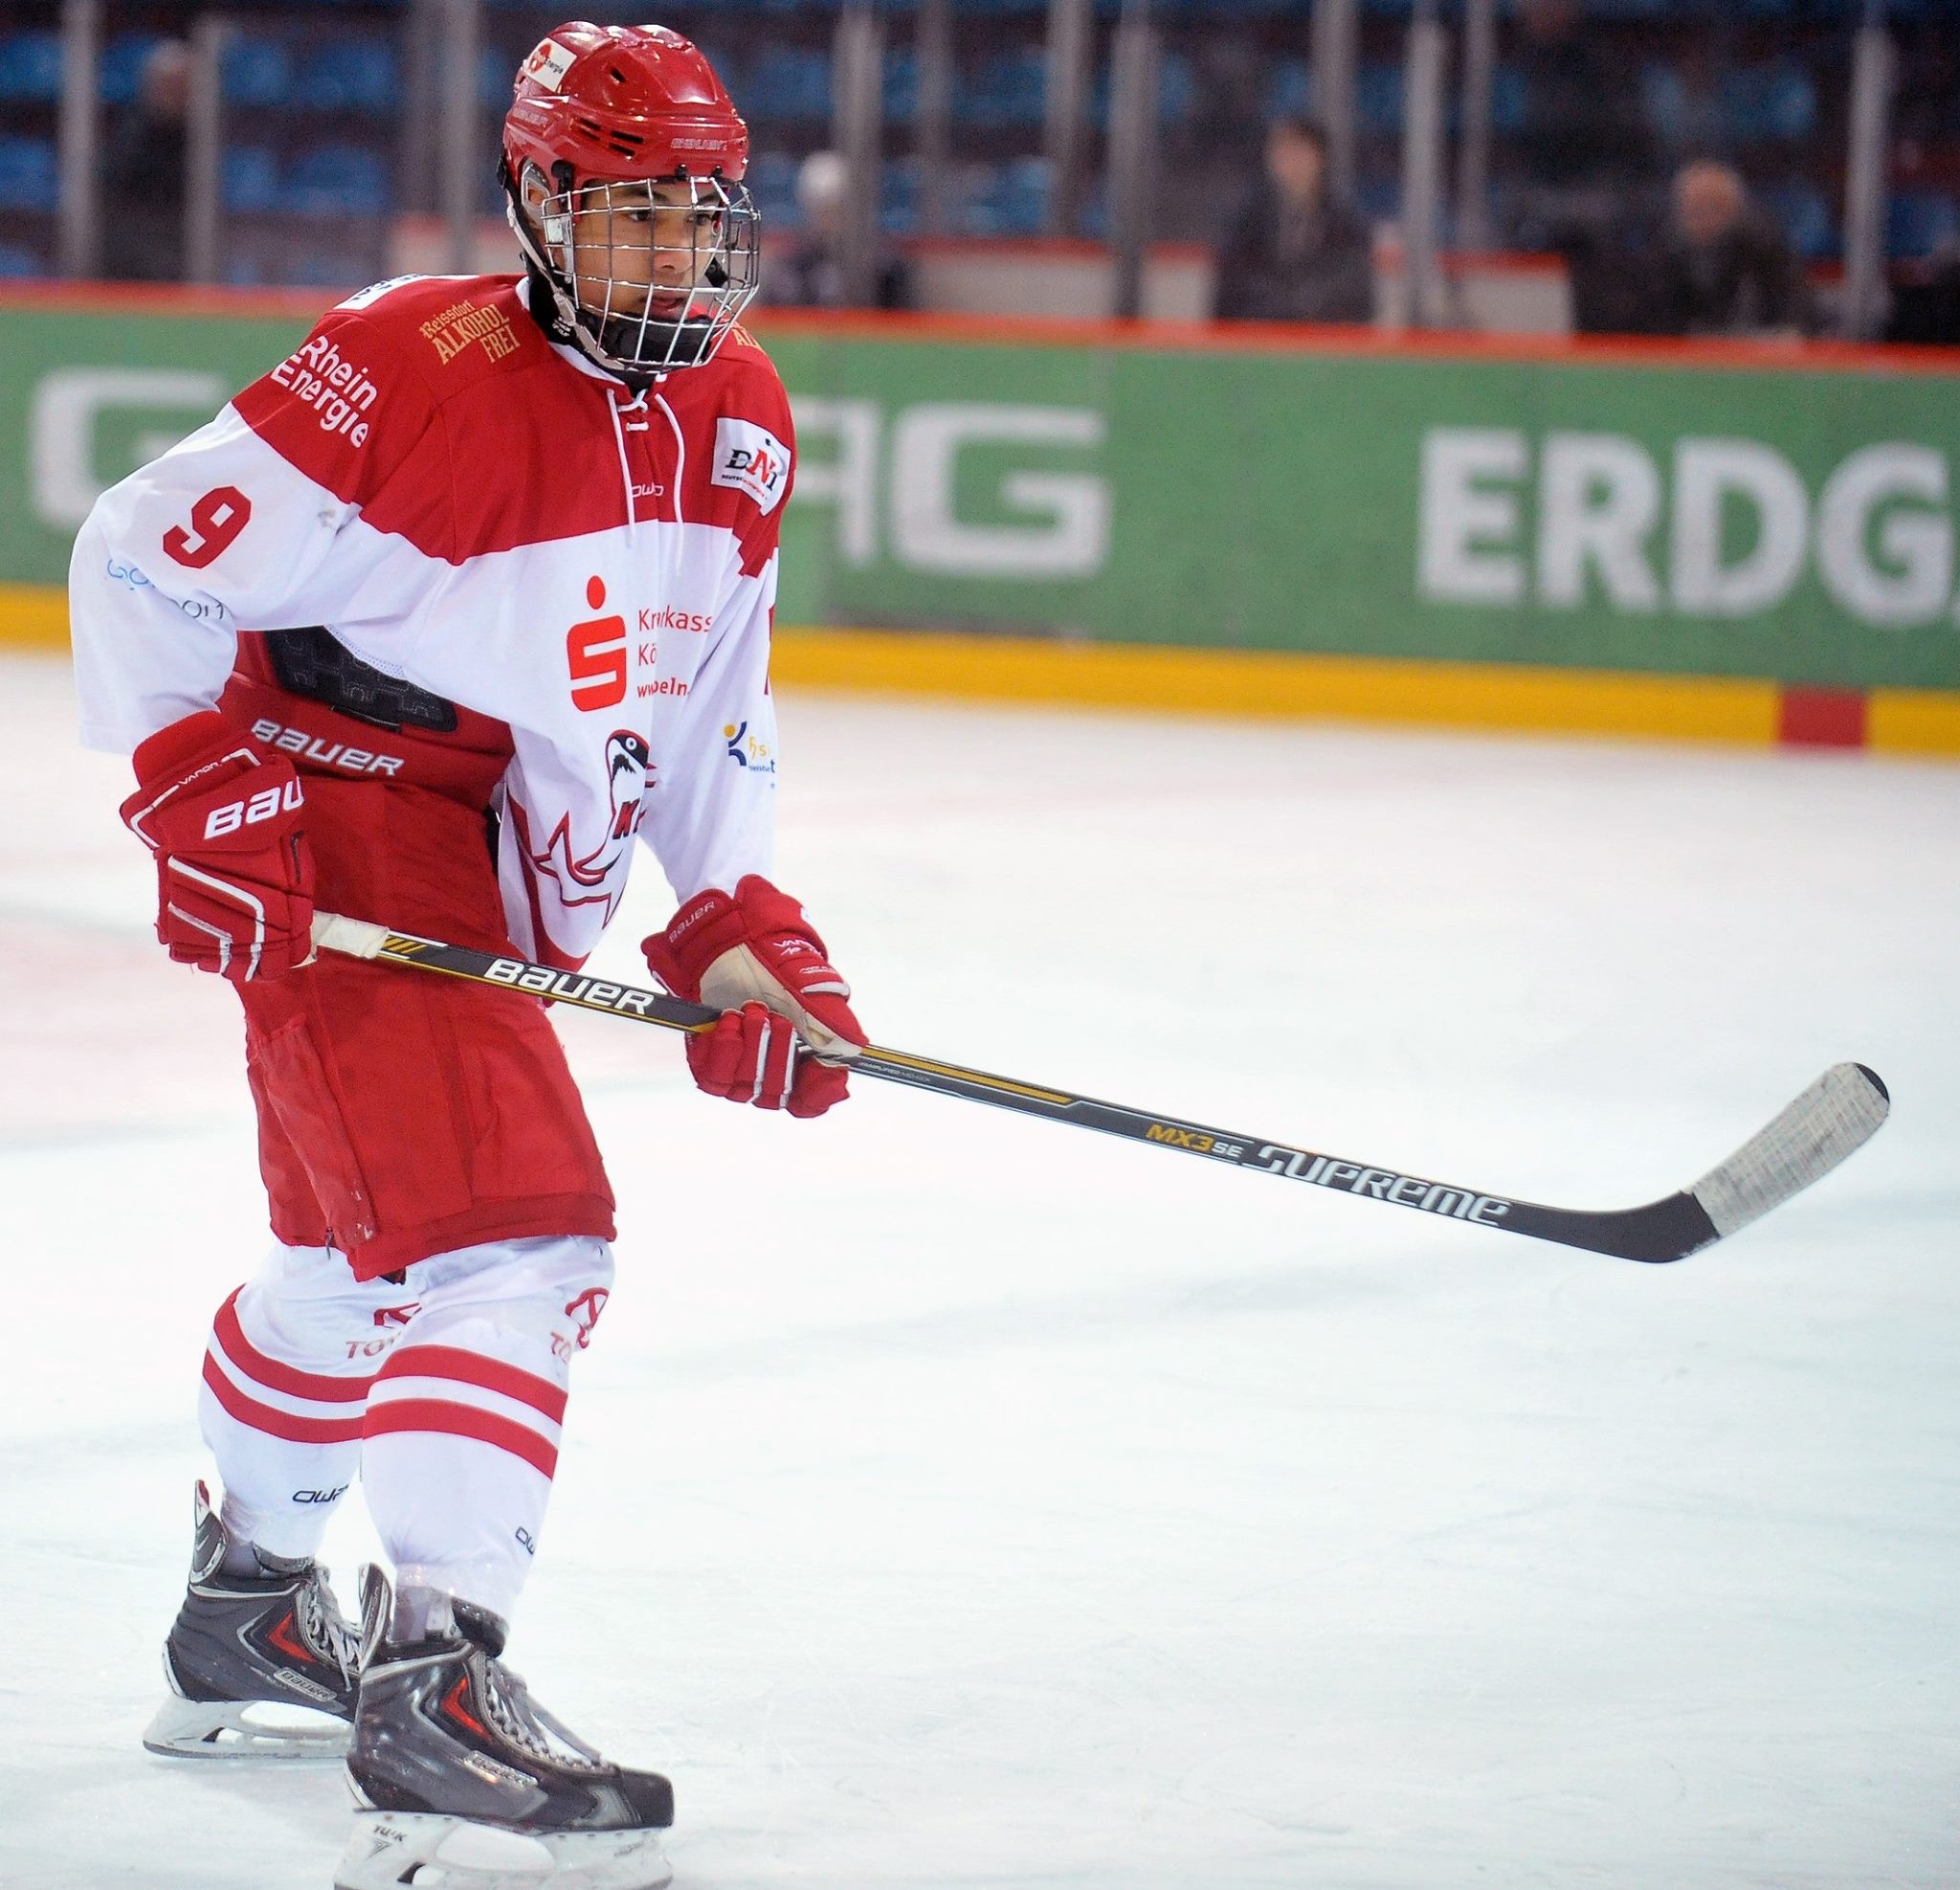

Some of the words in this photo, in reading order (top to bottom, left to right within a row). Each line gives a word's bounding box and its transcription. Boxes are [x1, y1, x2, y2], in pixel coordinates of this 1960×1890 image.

[432, 303, 510, 365] ALKOHOL
[479, 324, 521, 363] FREI
[270, 352, 369, 449] Energie
[299, 335, 378, 411] Rhein
[163, 485, 252, 569] 9
[1419, 425, 1960, 632] ERDG
[251, 718, 405, 777] BAUER
[483, 958, 655, 1015] BAUER
[1145, 1123, 1214, 1153] MX3
[1211, 1141, 1244, 1158] SE
[1245, 1145, 1513, 1227] SUPREME
